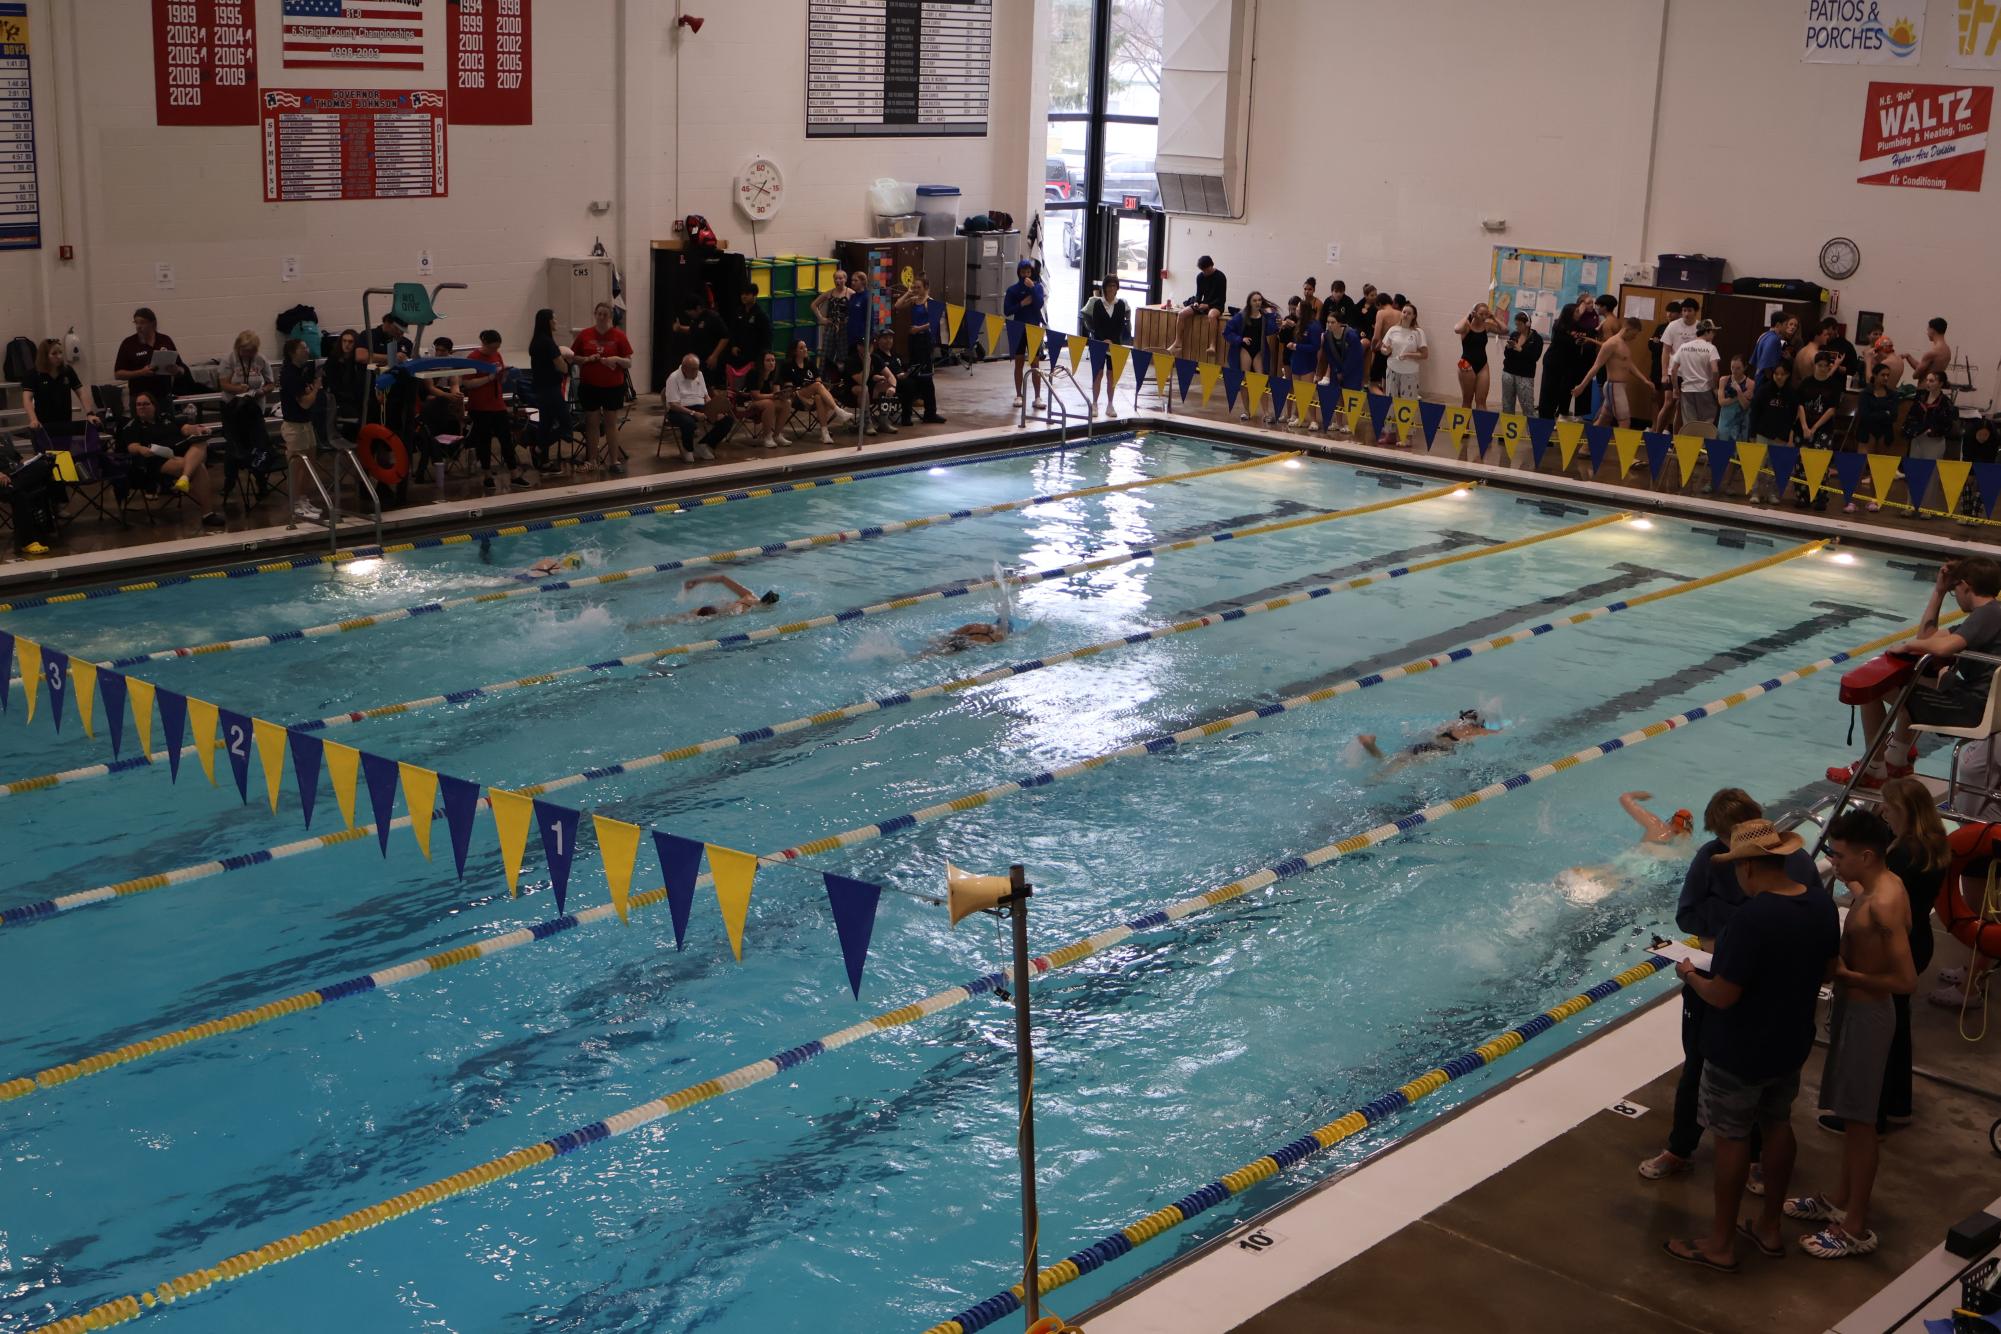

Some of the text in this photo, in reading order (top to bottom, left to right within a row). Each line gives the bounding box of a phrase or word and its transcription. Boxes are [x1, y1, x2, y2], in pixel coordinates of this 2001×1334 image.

[167, 5, 243, 25] 1989 1995
[497, 0, 521, 15] 1998
[1809, 0, 1880, 22] PATIOS &
[299, 25, 329, 39] Straight
[330, 27, 357, 40] County
[358, 28, 415, 41] Championships
[459, 15, 522, 34] 1999 2000
[167, 25, 244, 45] 2003 2004
[459, 34, 522, 52] 2001 2002
[1806, 27, 1884, 50] PORCHES
[168, 46, 245, 66] 2005 2006
[330, 47, 380, 58] 1998-2003
[458, 53, 522, 71] 2003 2005
[168, 67, 246, 86] 2008 2009
[458, 71, 522, 89] 2006 2007
[170, 87, 202, 106] 2020
[332, 89, 380, 99] GOVERNOR
[314, 98, 398, 109] THOMAS JOHNSON
[1879, 87, 1973, 139] WALTZ
[1877, 137, 1912, 152] Plumbing
[1914, 133, 1920, 143] &
[1958, 122, 1973, 132] Inc.
[1930, 144, 1956, 158] Division
[756, 164, 765, 172] 60
[772, 184, 780, 192] 15
[1889, 174, 1947, 189] Air Conditioning
[1124, 197, 1137, 209] EXIT
[573, 268, 588, 276] CHS
[1347, 396, 1518, 440] F C P S
[49, 662, 62, 691] 3
[231, 725, 246, 757] 2
[551, 819, 563, 856] 1
[1613, 1104, 1637, 1115] 8
[1240, 1234, 1274, 1252] 10
